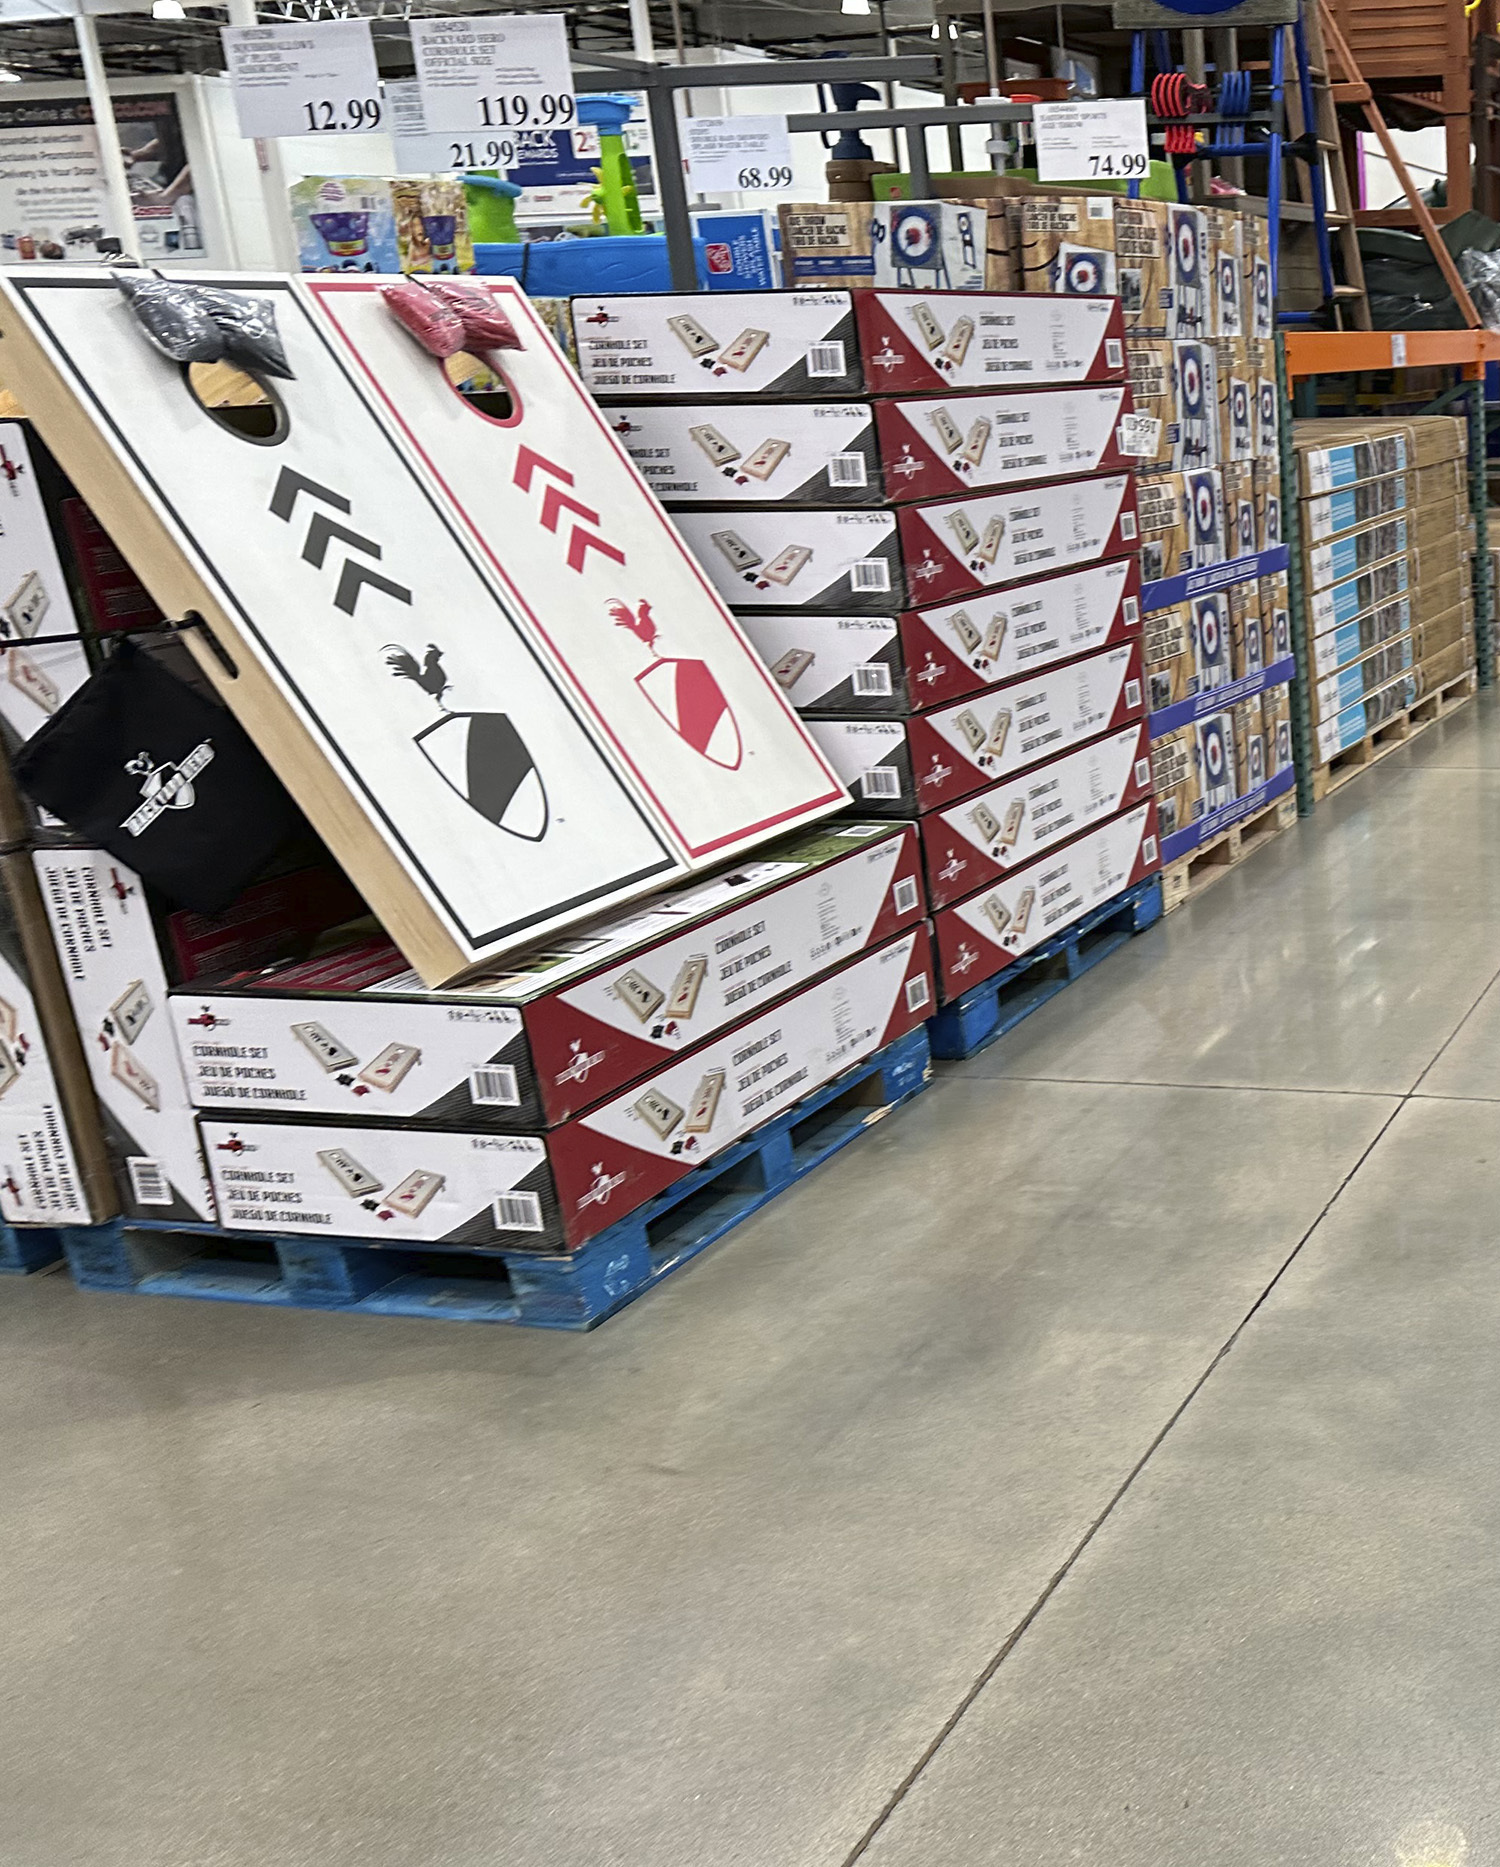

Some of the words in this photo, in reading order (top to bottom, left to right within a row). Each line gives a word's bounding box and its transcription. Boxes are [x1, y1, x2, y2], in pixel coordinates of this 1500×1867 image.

[303, 98, 381, 131] 12.99
[477, 94, 575, 127] 119.99
[450, 140, 514, 168] 21.99
[1088, 153, 1146, 176] 74.99
[738, 166, 793, 189] 68.99
[588, 340, 631, 350] CORNHOLE
[633, 339, 648, 349] SET
[608, 357, 617, 367] DE
[620, 357, 653, 367] POCHES
[593, 375, 618, 385] JUEGO
[620, 375, 630, 385] DE
[632, 374, 676, 384] CORNHOLE
[193, 1045, 246, 1059] CORNHOLE
[249, 1047, 268, 1059] SET
[198, 1065, 220, 1077] JEU
[221, 1066, 233, 1078] DE
[235, 1067, 276, 1079] POCHES
[202, 1085, 234, 1097] JUEGO
[237, 1086, 249, 1098] DE
[251, 1087, 306, 1100] CORNHOLE
[222, 1169, 274, 1183] CORNHOLE
[277, 1171, 295, 1183] SET
[228, 1189, 247, 1200] JEU
[249, 1190, 260, 1201] DE
[263, 1191, 302, 1203] POCHES
[231, 1209, 263, 1221] JUEGO
[265, 1210, 277, 1222] DE
[279, 1211, 333, 1225] CORNHOLE
